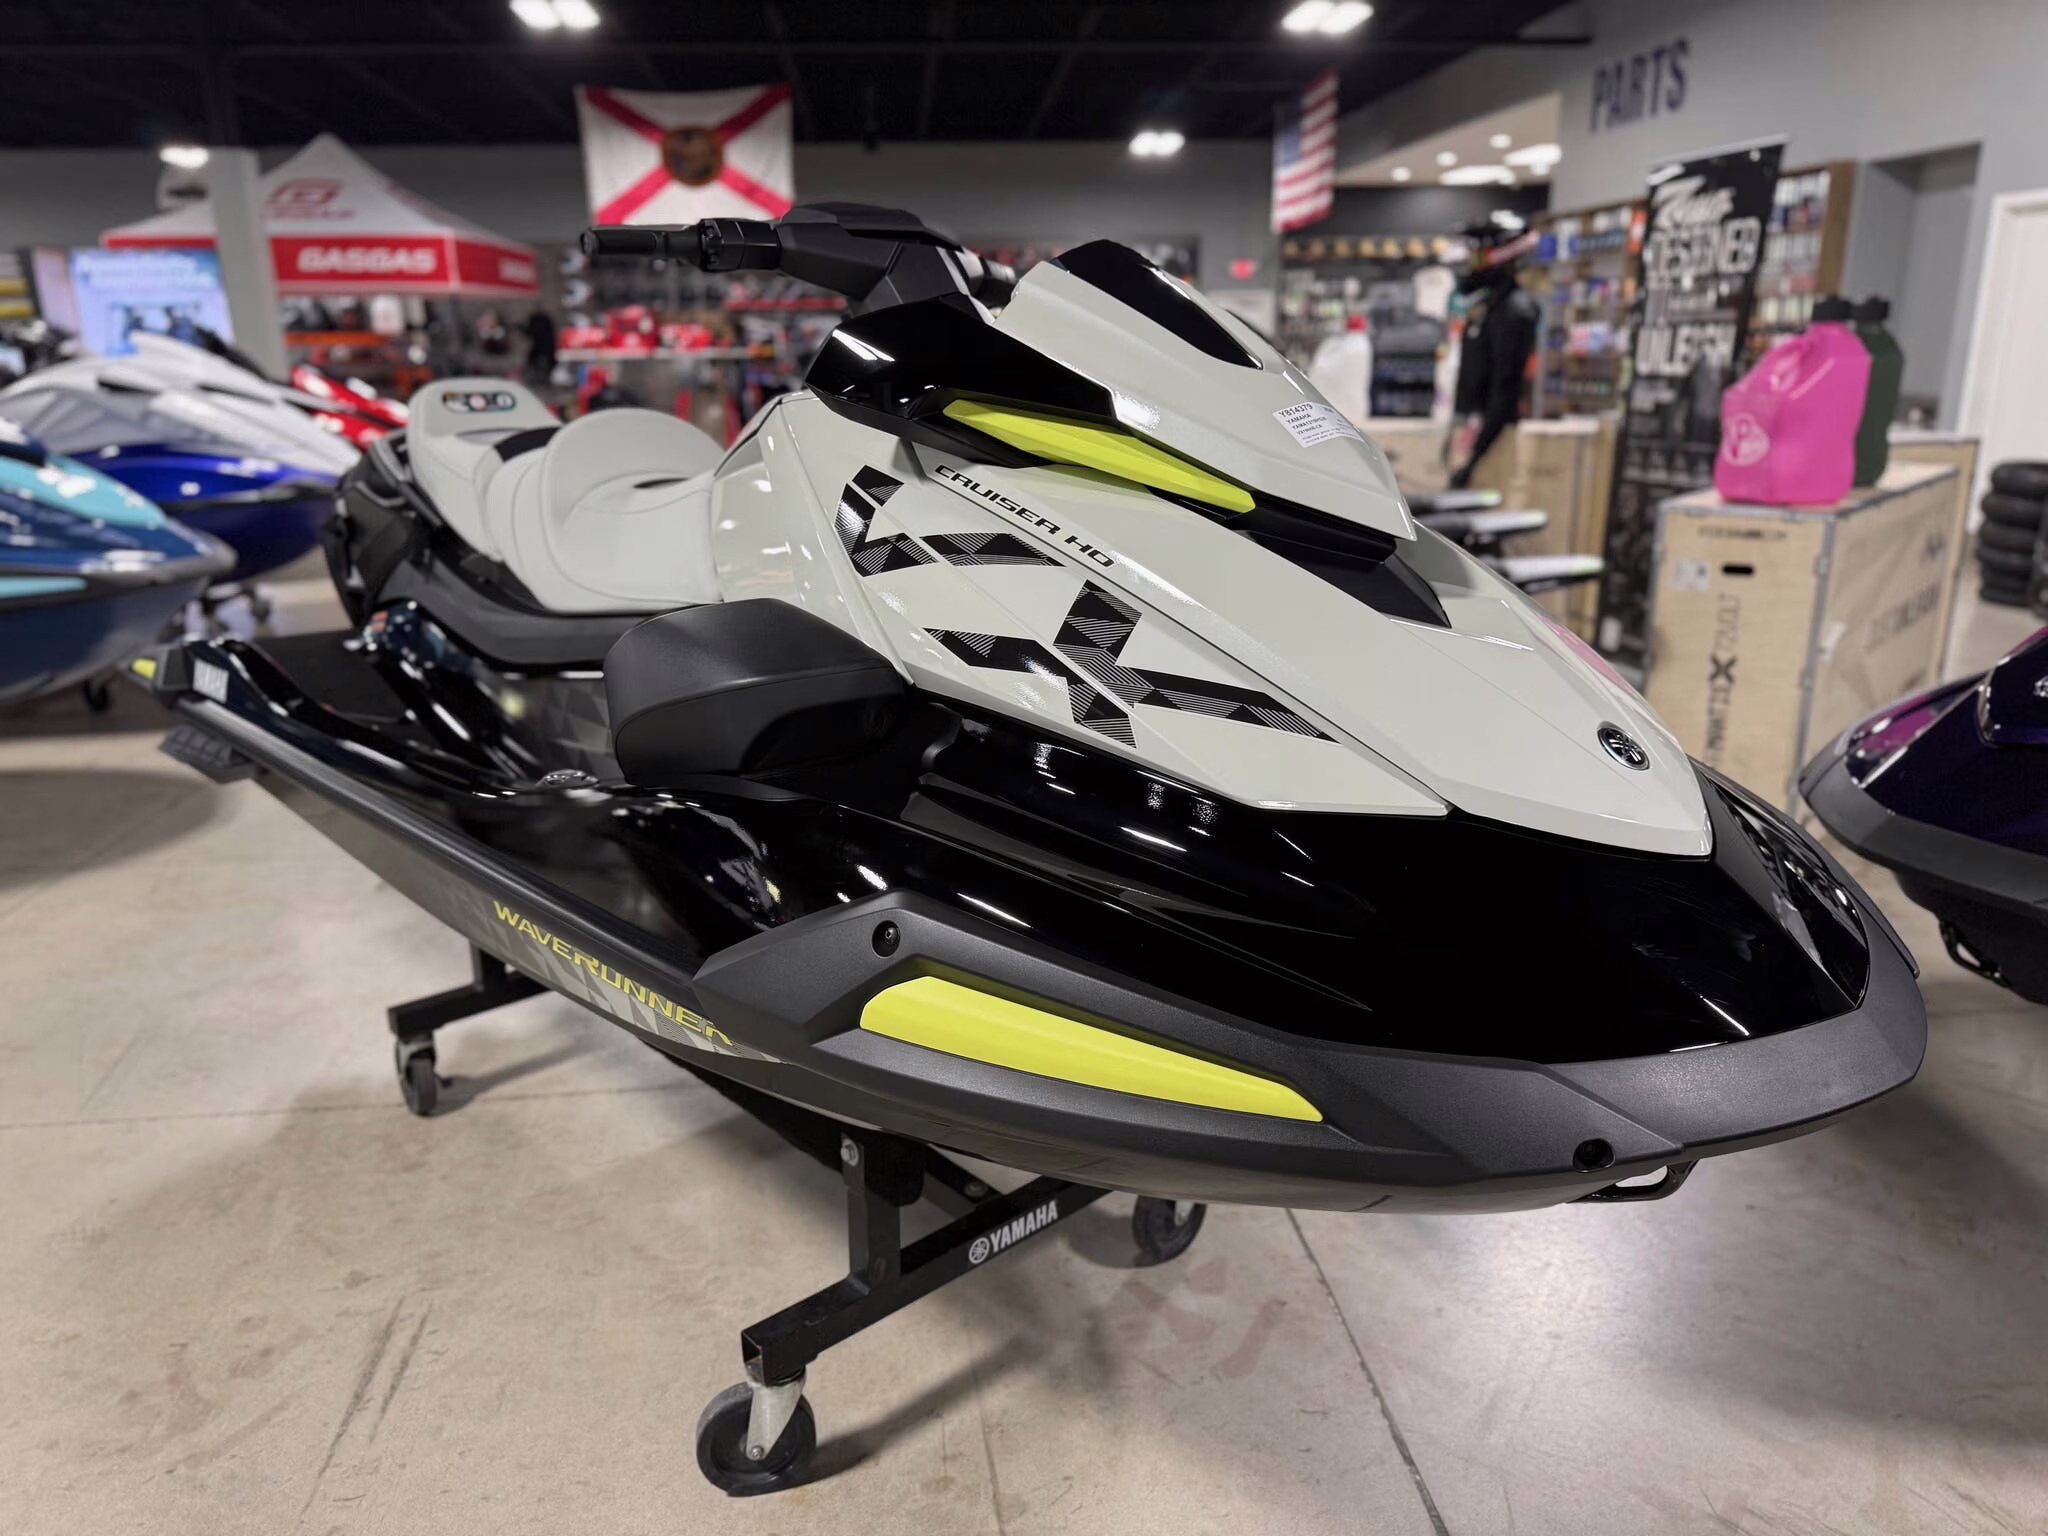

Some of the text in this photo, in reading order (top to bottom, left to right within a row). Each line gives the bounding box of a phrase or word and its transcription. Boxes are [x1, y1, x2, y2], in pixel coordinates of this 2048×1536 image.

[1590, 40, 1690, 132] PARTS
[297, 246, 438, 274] GASGAS
[934, 465, 1115, 567] CRUISER HO
[494, 901, 734, 1047] WAVERUNNER
[990, 1200, 1058, 1253] YAMAHA
